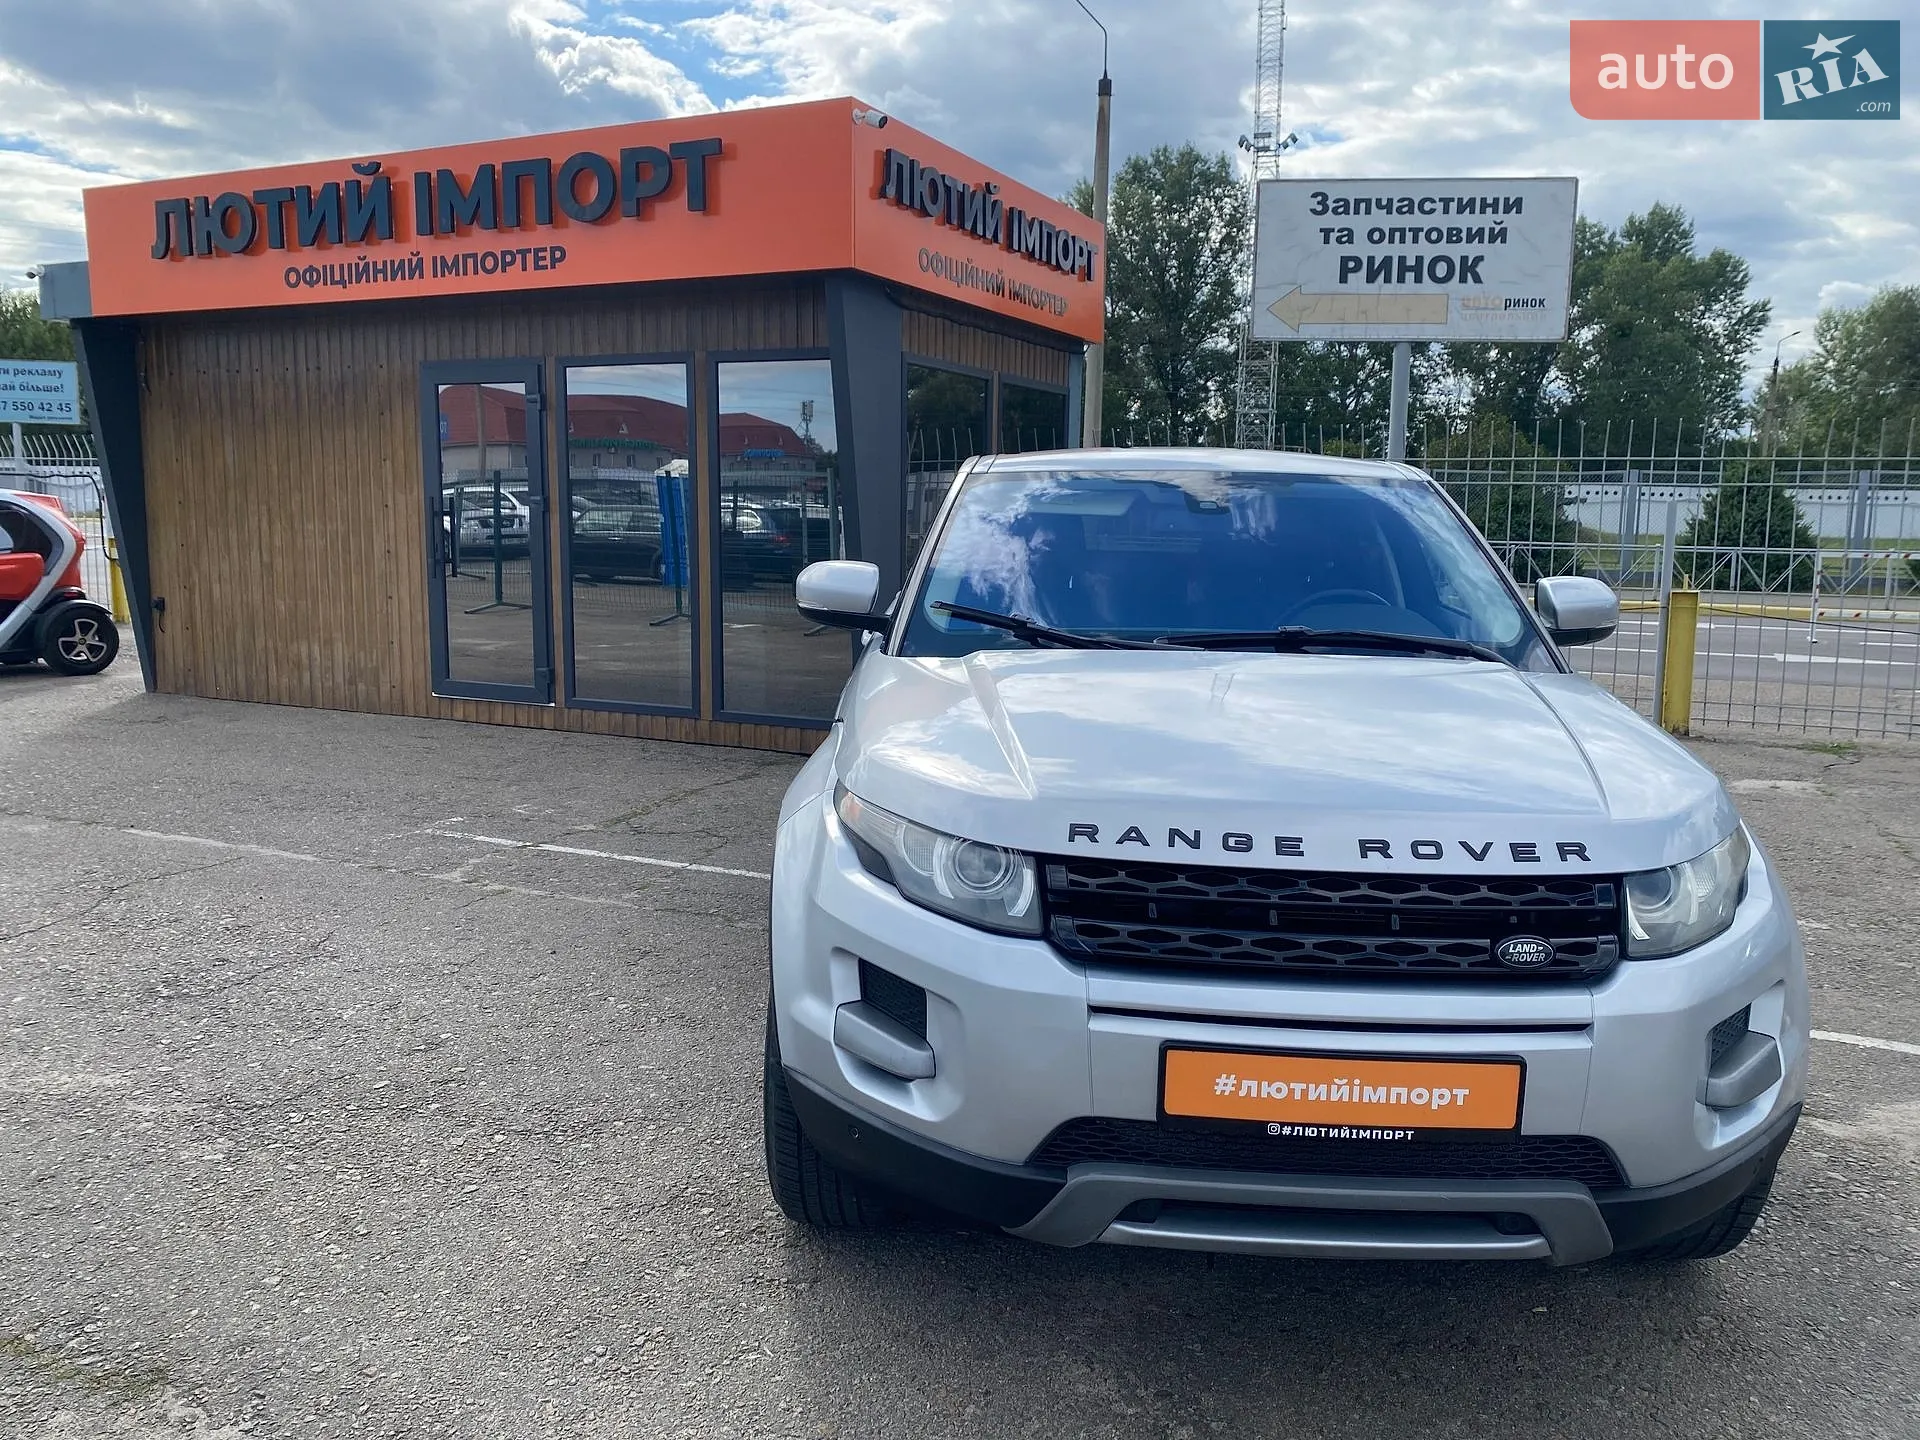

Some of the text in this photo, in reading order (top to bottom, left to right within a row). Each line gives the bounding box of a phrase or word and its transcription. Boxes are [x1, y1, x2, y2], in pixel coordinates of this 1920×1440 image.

[151, 138, 723, 260] ЛЮТИЙ ІМПОРТ
[1309, 191, 1524, 216] Запчастини
[880, 148, 1099, 282] ЛЮТИЙ ІМПОРТ
[1319, 220, 1508, 245] та оптовий
[284, 245, 567, 289] ОФІЦІЙНИЙ ІМПОРТЕР
[1338, 255, 1485, 285] РИНОК
[918, 247, 1069, 317] ОФІЦІЙНИЙ ІМПОРТЕР
[13, 367, 63, 379] рекламу
[19, 381, 64, 393] більше!
[12, 401, 34, 412] 550
[38, 402, 53, 412] 42
[57, 402, 72, 413] 45
[1068, 823, 1592, 863] RANGE ROVER
[1509, 943, 1538, 953] LAND
[1511, 953, 1546, 962] ROVER
[1214, 1073, 1470, 1110] #лютийімпорт
